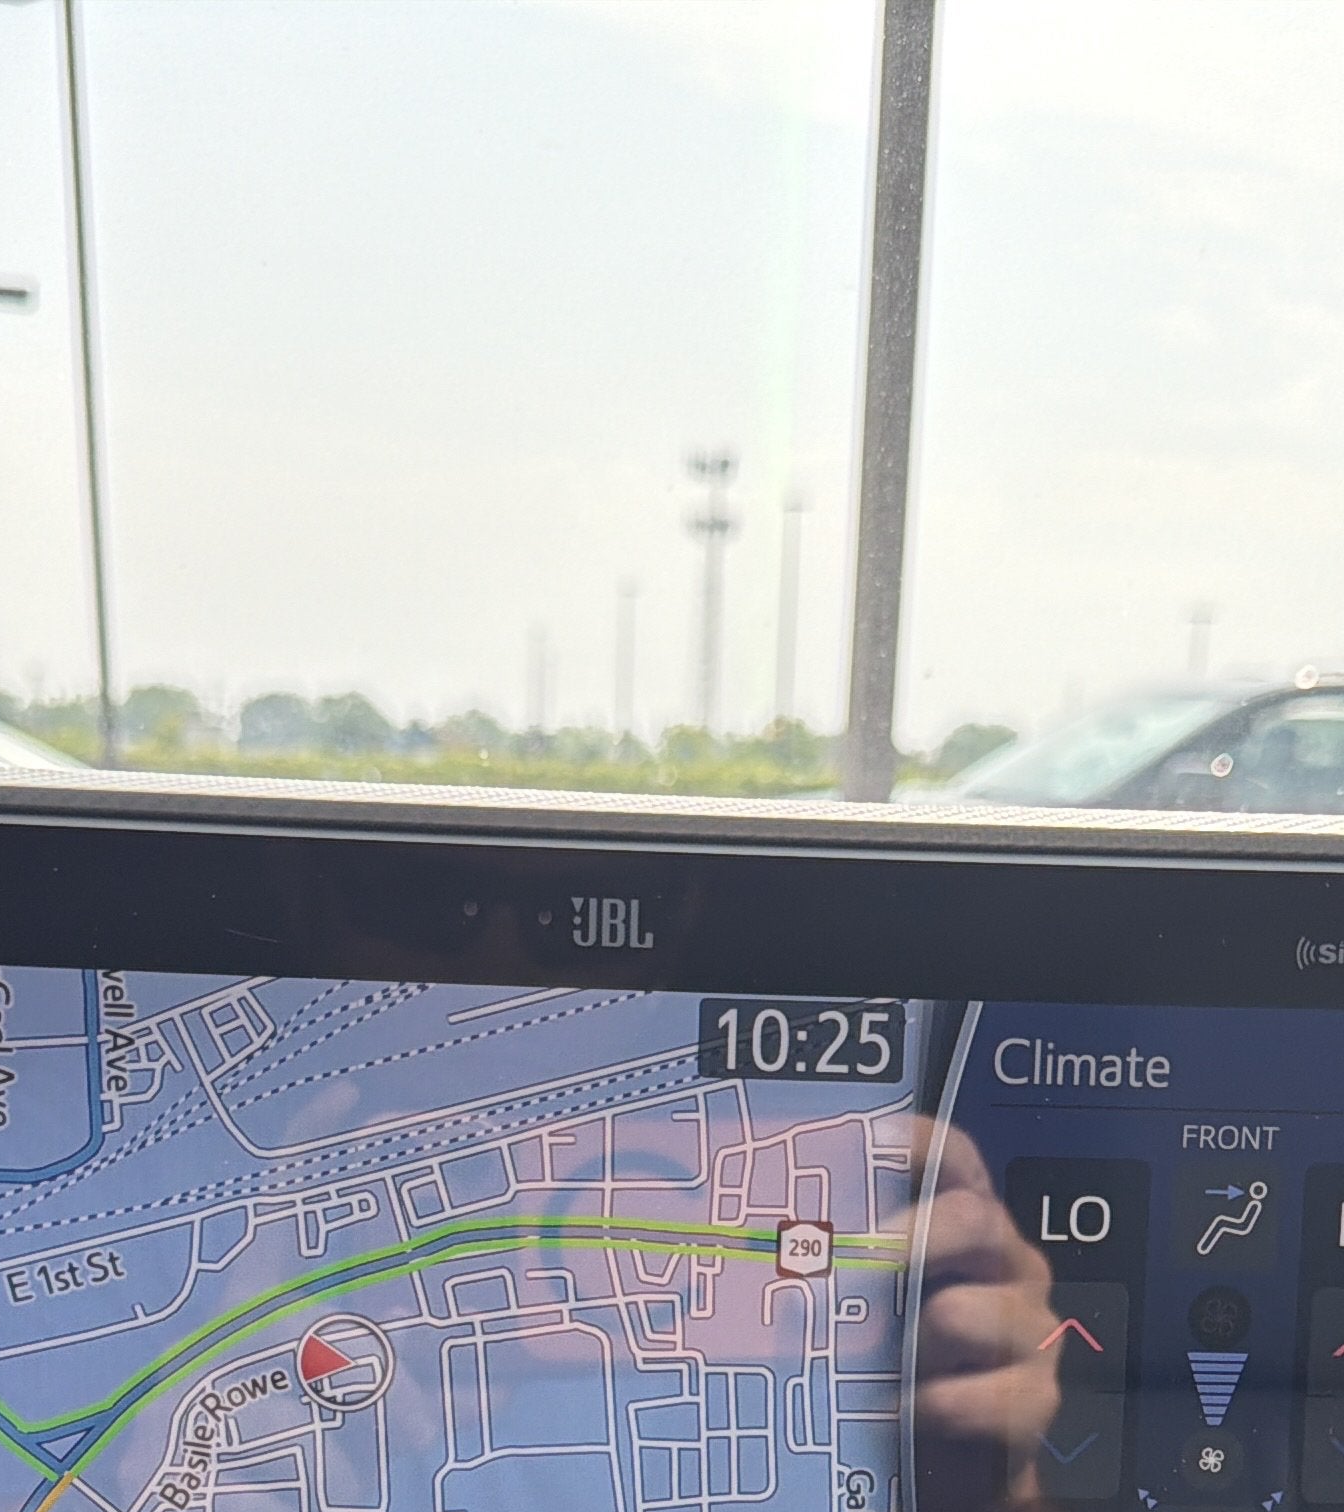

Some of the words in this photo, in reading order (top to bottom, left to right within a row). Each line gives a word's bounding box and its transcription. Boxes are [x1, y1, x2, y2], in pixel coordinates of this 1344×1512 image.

[572, 896, 653, 950] JBL
[105, 1028, 136, 1093] Ave
[718, 1008, 891, 1075] 10:25
[993, 1038, 1170, 1089] Climate
[1182, 1125, 1280, 1150] FRONT
[1041, 1196, 1111, 1243] LO
[789, 1237, 822, 1258] 290
[6, 1272, 30, 1303] E
[37, 1260, 84, 1297] 1st
[89, 1251, 124, 1283] St
[159, 1424, 216, 1510] Basile
[199, 1369, 289, 1422] Rowe
